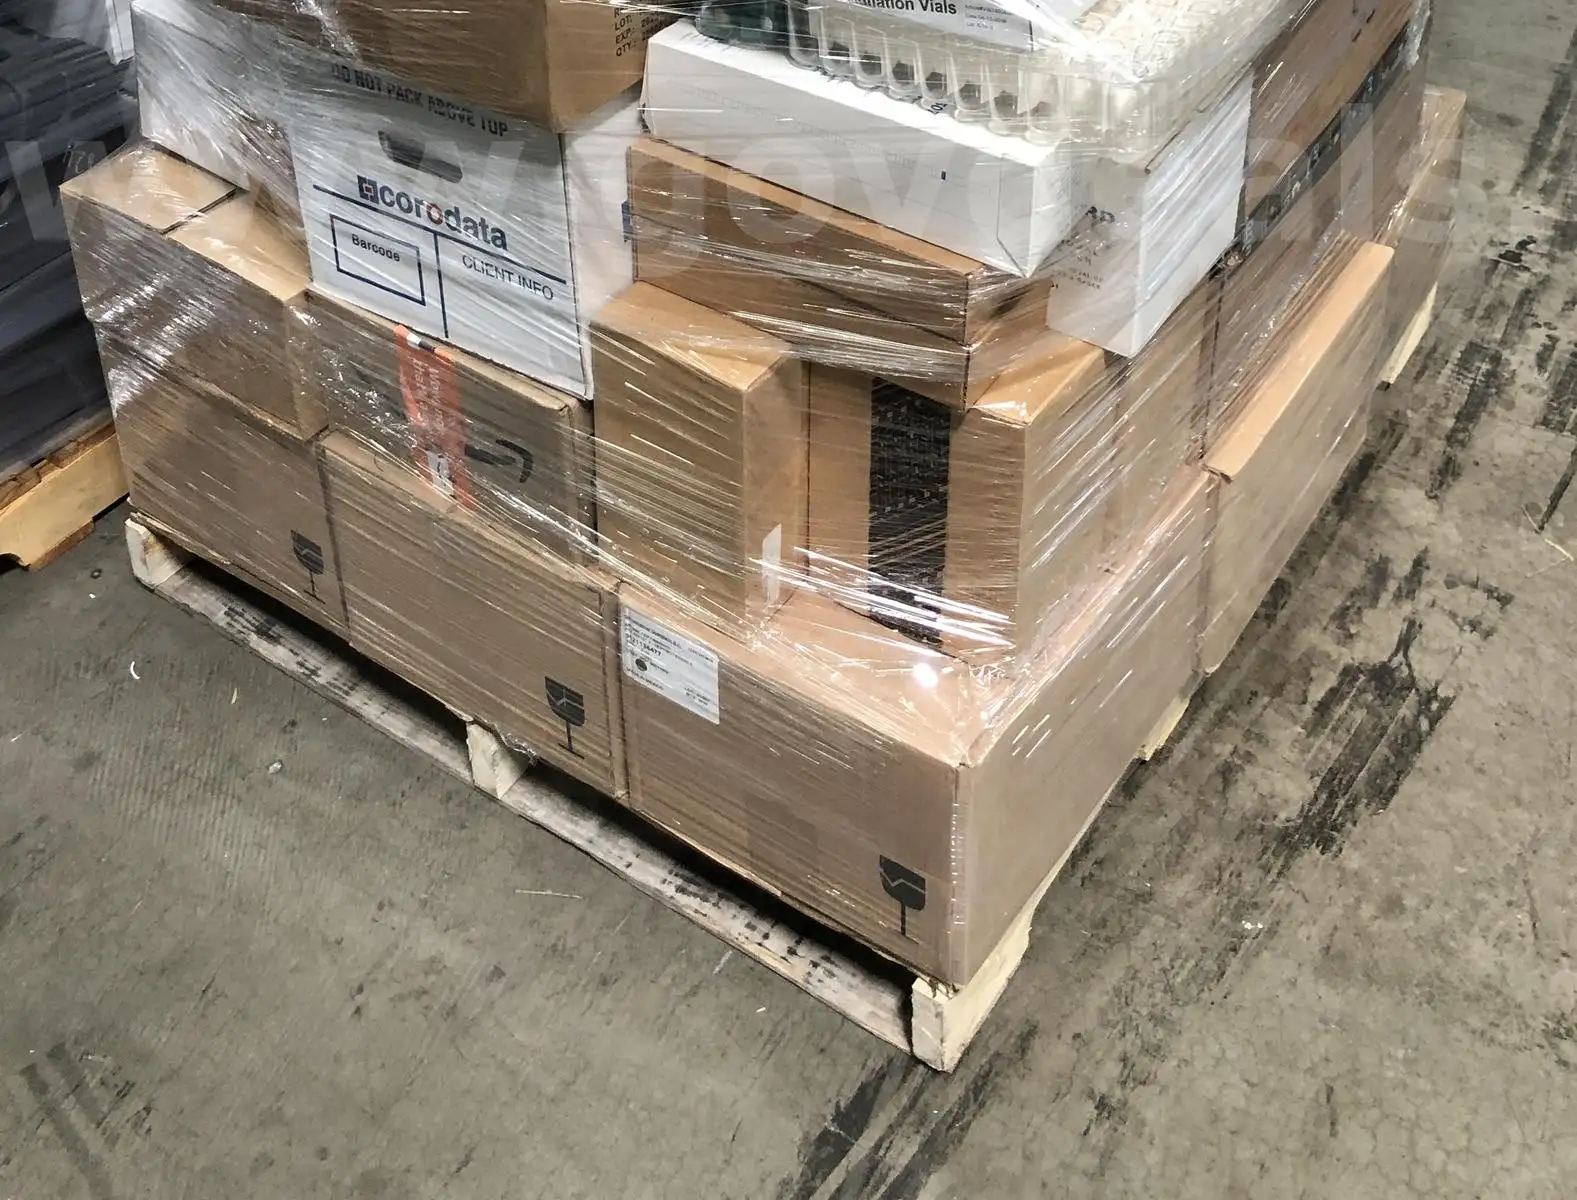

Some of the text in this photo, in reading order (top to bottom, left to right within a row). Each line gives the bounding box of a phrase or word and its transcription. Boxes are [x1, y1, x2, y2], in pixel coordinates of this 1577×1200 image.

[355, 66, 384, 93] NOT
[387, 82, 424, 108] PACK
[378, 185, 509, 252] corodata
[351, 233, 401, 262] Barcode
[462, 254, 554, 301] CLIENT INFO
